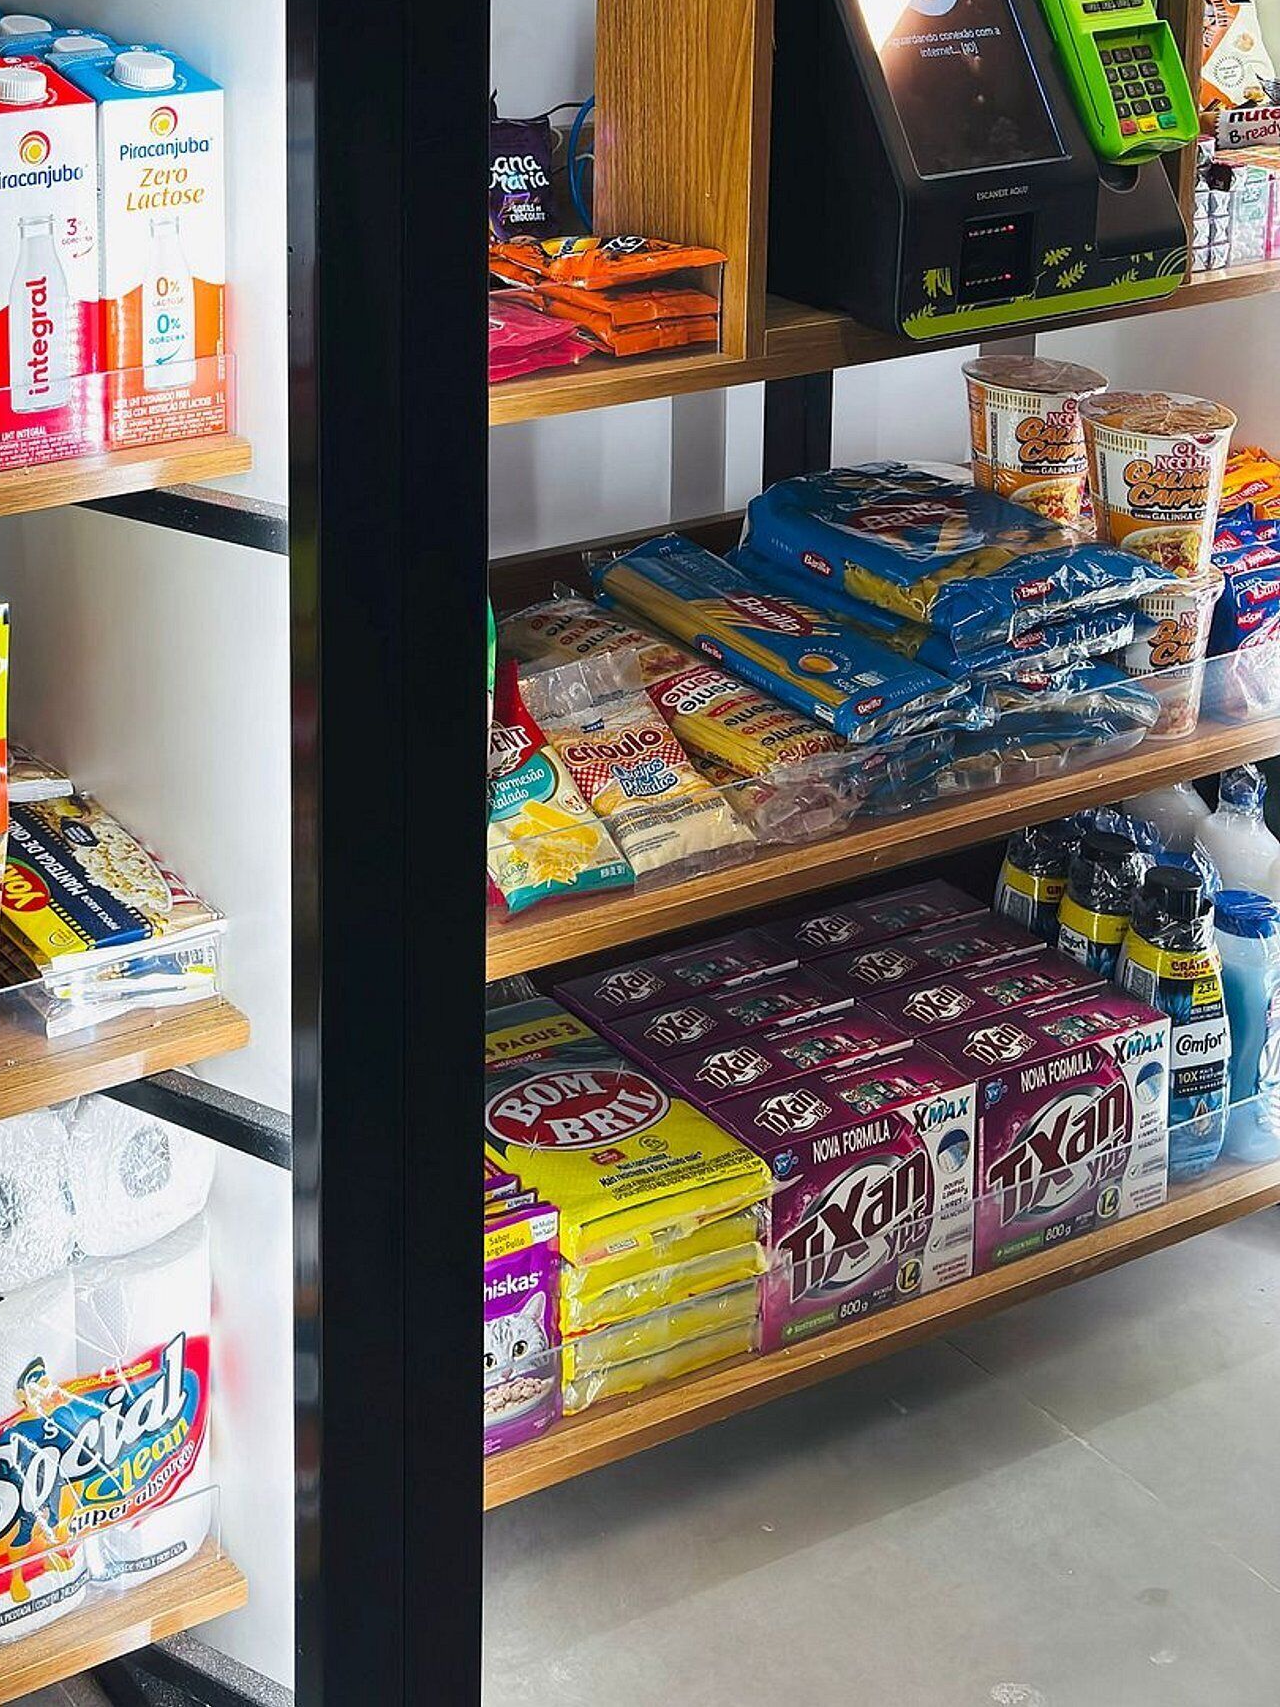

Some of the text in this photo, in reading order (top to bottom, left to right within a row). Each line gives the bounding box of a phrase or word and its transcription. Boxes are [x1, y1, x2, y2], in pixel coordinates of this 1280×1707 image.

[119, 138, 210, 162] Piracanjuba
[139, 164, 189, 190] Zero
[126, 186, 206, 212] Lactose
[156, 276, 181, 298] 0%
[28, 276, 56, 397] integral
[157, 313, 182, 335] 0%
[1152, 511, 1193, 522] GALINHA
[805, 554, 832, 576] Barilla
[733, 595, 813, 636] Barilla
[856, 696, 883, 714] Barilla
[564, 729, 663, 765] crioulo
[496, 1021, 582, 1053] PAGUE 3
[1112, 1028, 1165, 1067] XMAX
[1020, 1063, 1053, 1094] NOVA
[495, 1071, 608, 1127] BOM
[544, 1088, 660, 1145] BRIL
[912, 1095, 971, 1135] XMAX
[812, 1132, 841, 1163] NOVA
[840, 1300, 862, 1319] 800
[84, 1417, 190, 1506] Clean
